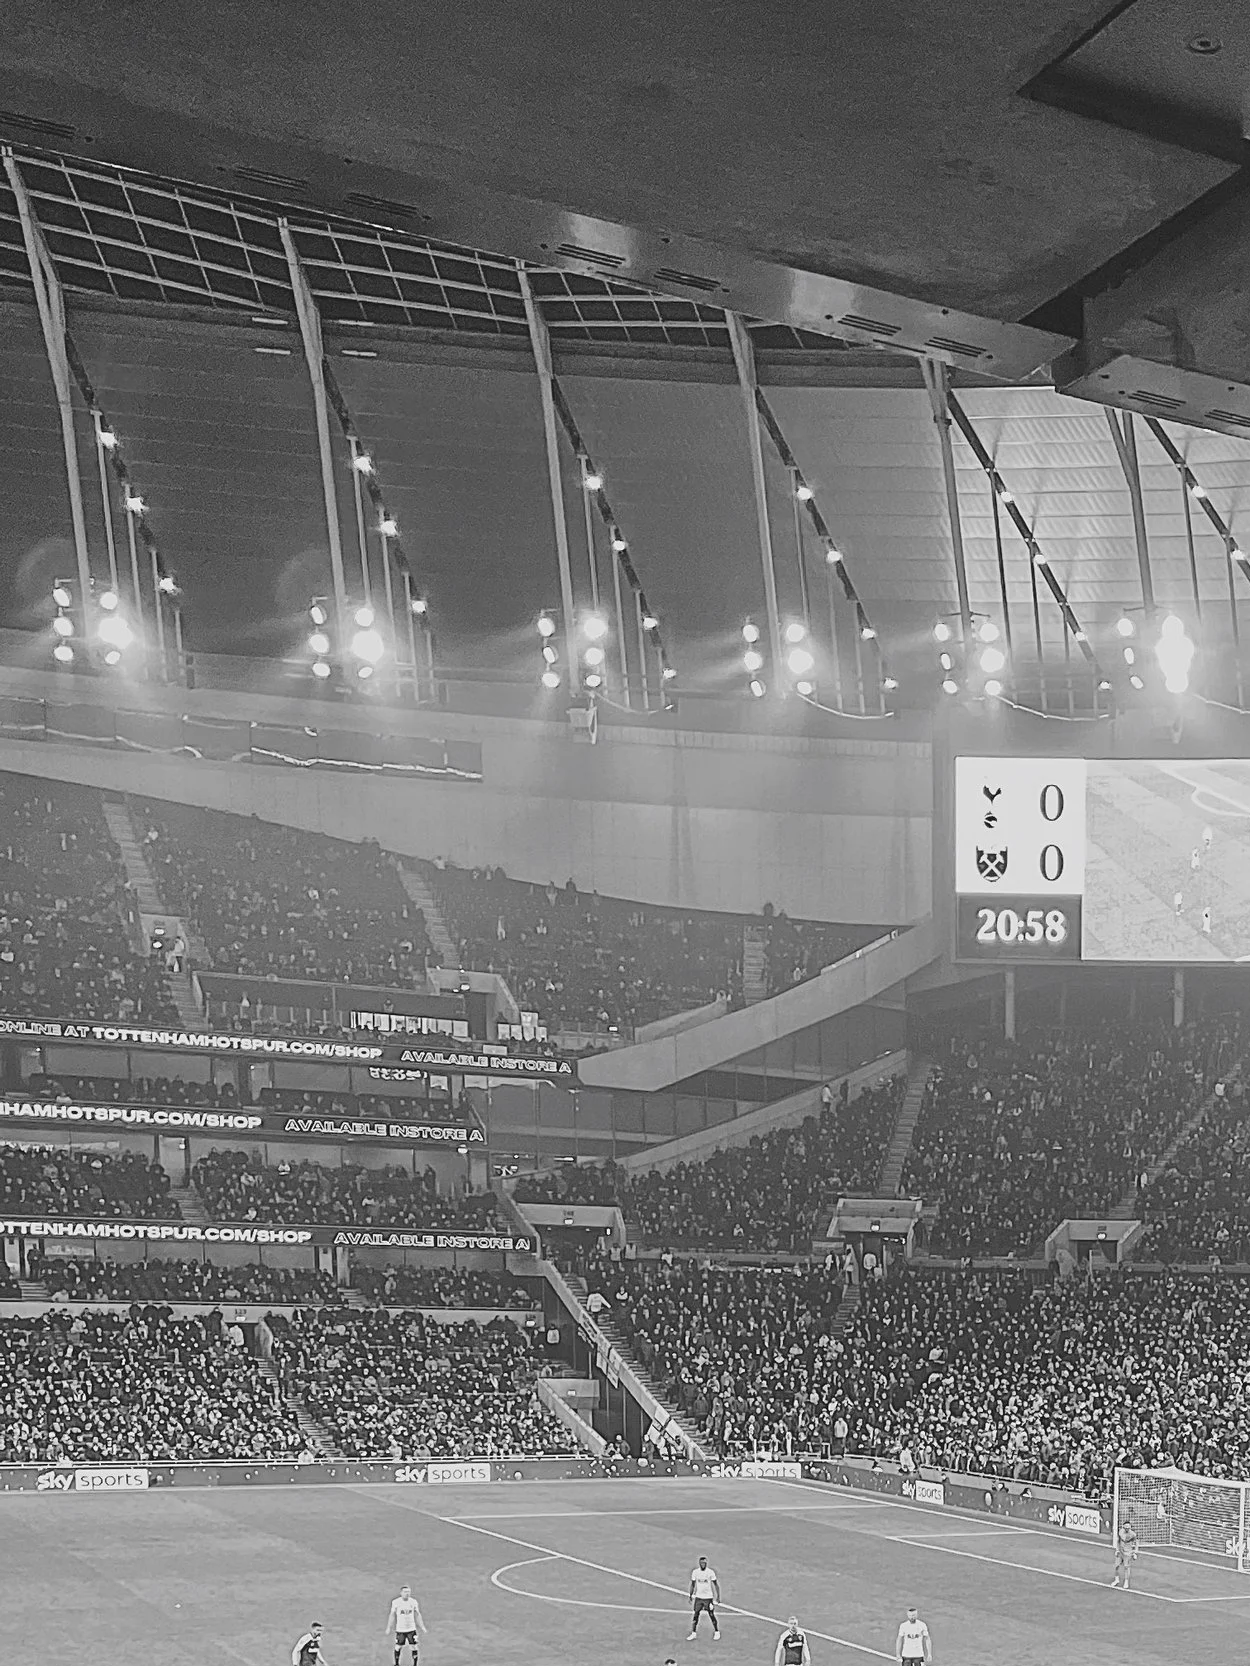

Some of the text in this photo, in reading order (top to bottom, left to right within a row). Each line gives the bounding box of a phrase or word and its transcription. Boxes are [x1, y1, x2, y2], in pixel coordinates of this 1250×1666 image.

[1039, 784, 1064, 822] 0
[1039, 844, 1064, 882] 0
[977, 908, 1067, 942] 20:58
[64, 1026, 90, 1038] AT
[92, 1027, 383, 1059] TOTTENHAMHOTSPUR.COM/SHOP
[400, 1050, 489, 1067] AVAILABLE
[490, 1057, 557, 1072] INSTORE
[284, 1119, 387, 1136] AVAILABLE
[389, 1124, 467, 1140] INSTORE
[334, 1232, 434, 1247] AVAILABLE
[436, 1235, 514, 1250] INSTORE
[37, 1470, 143, 1490] sky sports
[395, 1465, 486, 1484] sky sports
[902, 1479, 916, 1500] sky
[1047, 1504, 1098, 1528] sky sports
